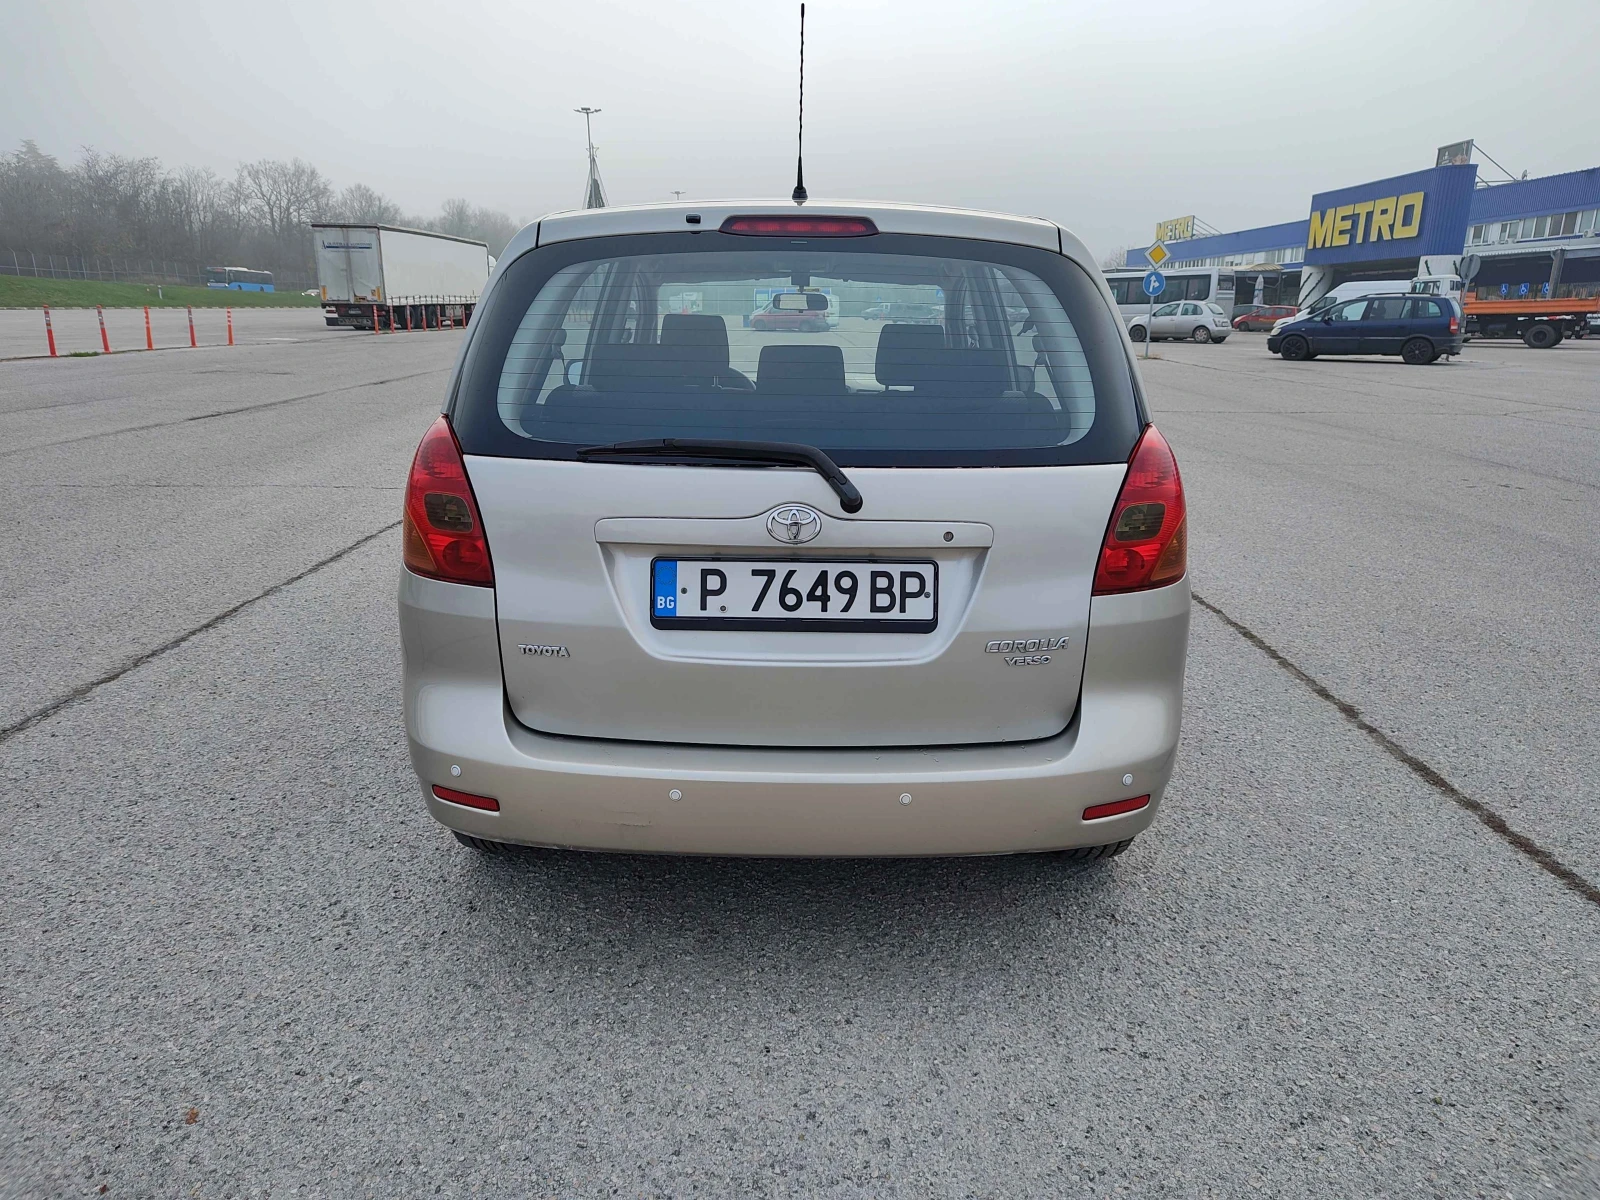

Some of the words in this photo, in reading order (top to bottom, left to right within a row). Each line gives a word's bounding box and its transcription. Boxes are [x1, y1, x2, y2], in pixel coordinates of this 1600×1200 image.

[1156, 215, 1194, 241] METRO
[1307, 191, 1424, 250] METRO
[700, 568, 727, 611] P
[751, 569, 859, 613] 7649
[869, 570, 926, 613] BP
[657, 596, 675, 609] BG
[517, 644, 571, 658] TOYOTA
[985, 636, 1070, 653] COROLLA
[1004, 655, 1051, 667] VERSO
